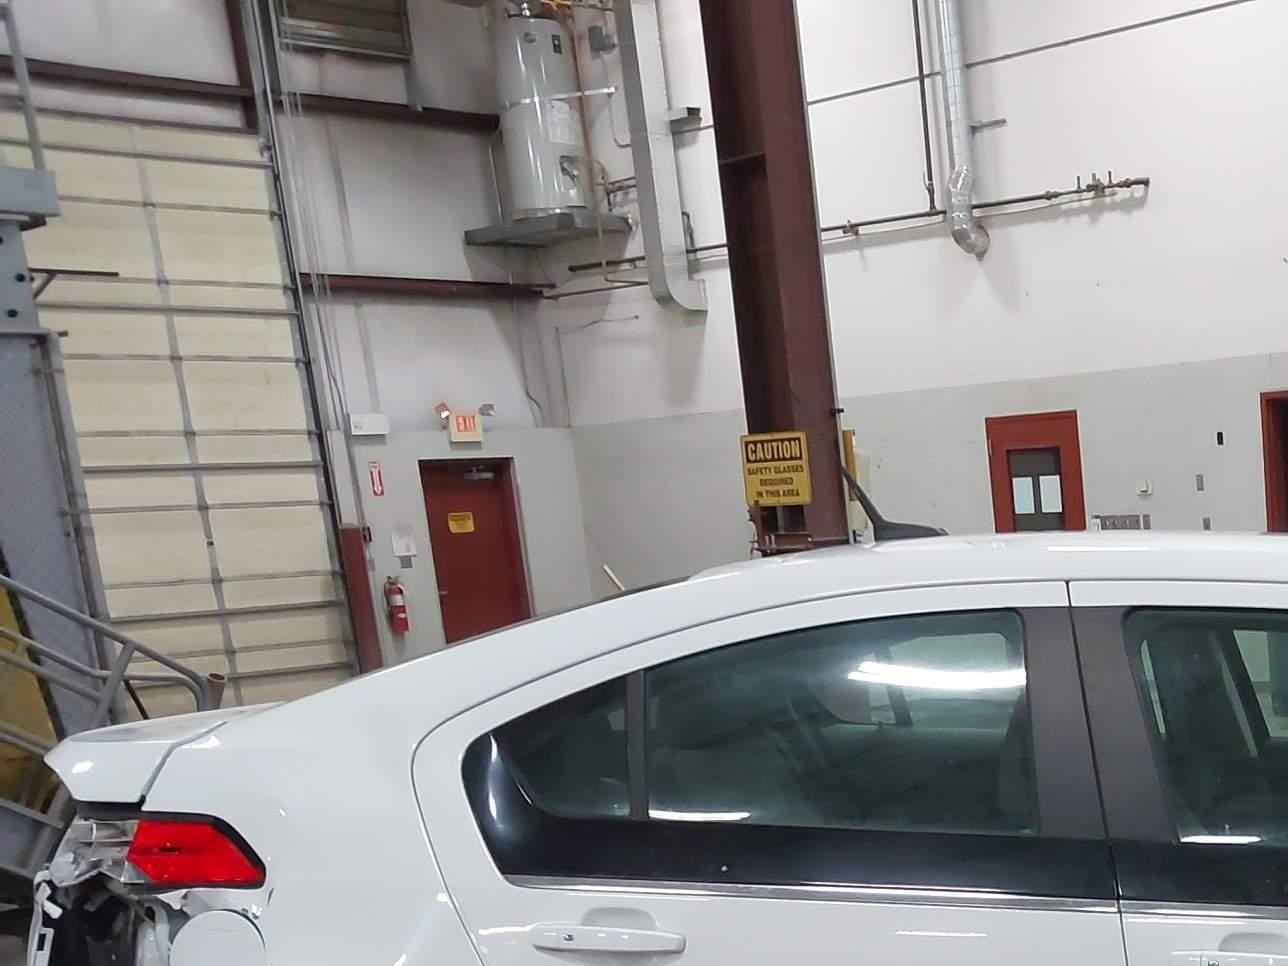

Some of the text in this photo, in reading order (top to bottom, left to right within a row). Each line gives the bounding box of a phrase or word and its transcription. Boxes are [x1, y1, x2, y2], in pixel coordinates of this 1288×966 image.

[455, 415, 476, 433] EXIT
[747, 439, 800, 461] CAUTION
[747, 464, 804, 476] SAFETY GLASSES
